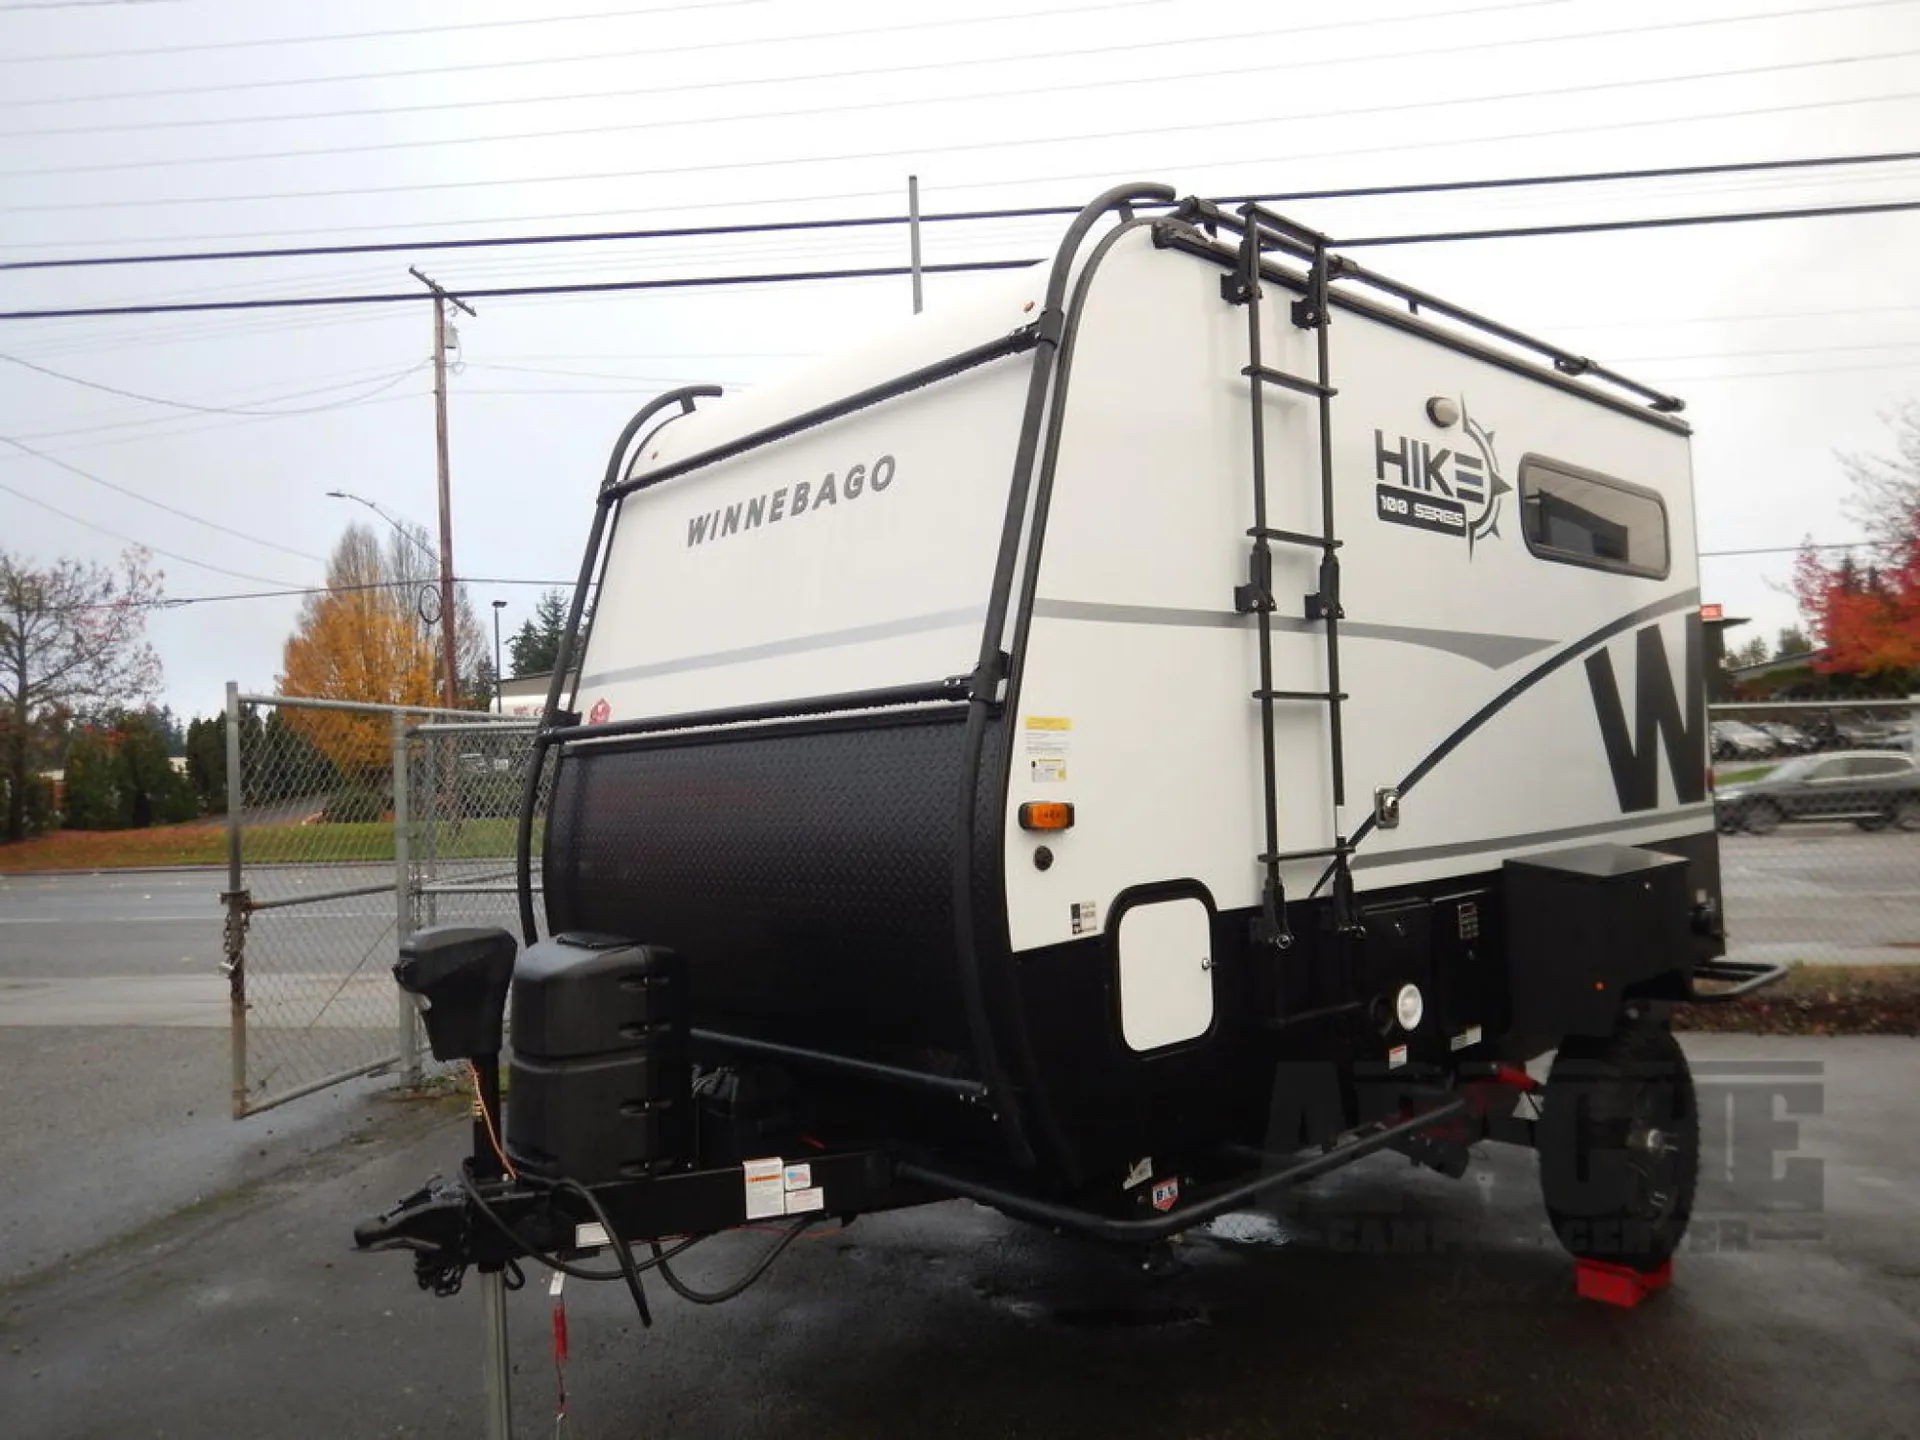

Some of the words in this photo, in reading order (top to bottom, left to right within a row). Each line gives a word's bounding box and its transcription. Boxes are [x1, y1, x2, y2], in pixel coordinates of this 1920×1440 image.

[687, 454, 896, 548] WINNEBAGO
[1374, 429, 1486, 505] HIKE
[1380, 494, 1409, 515] 100
[1413, 502, 1465, 528] SERIES
